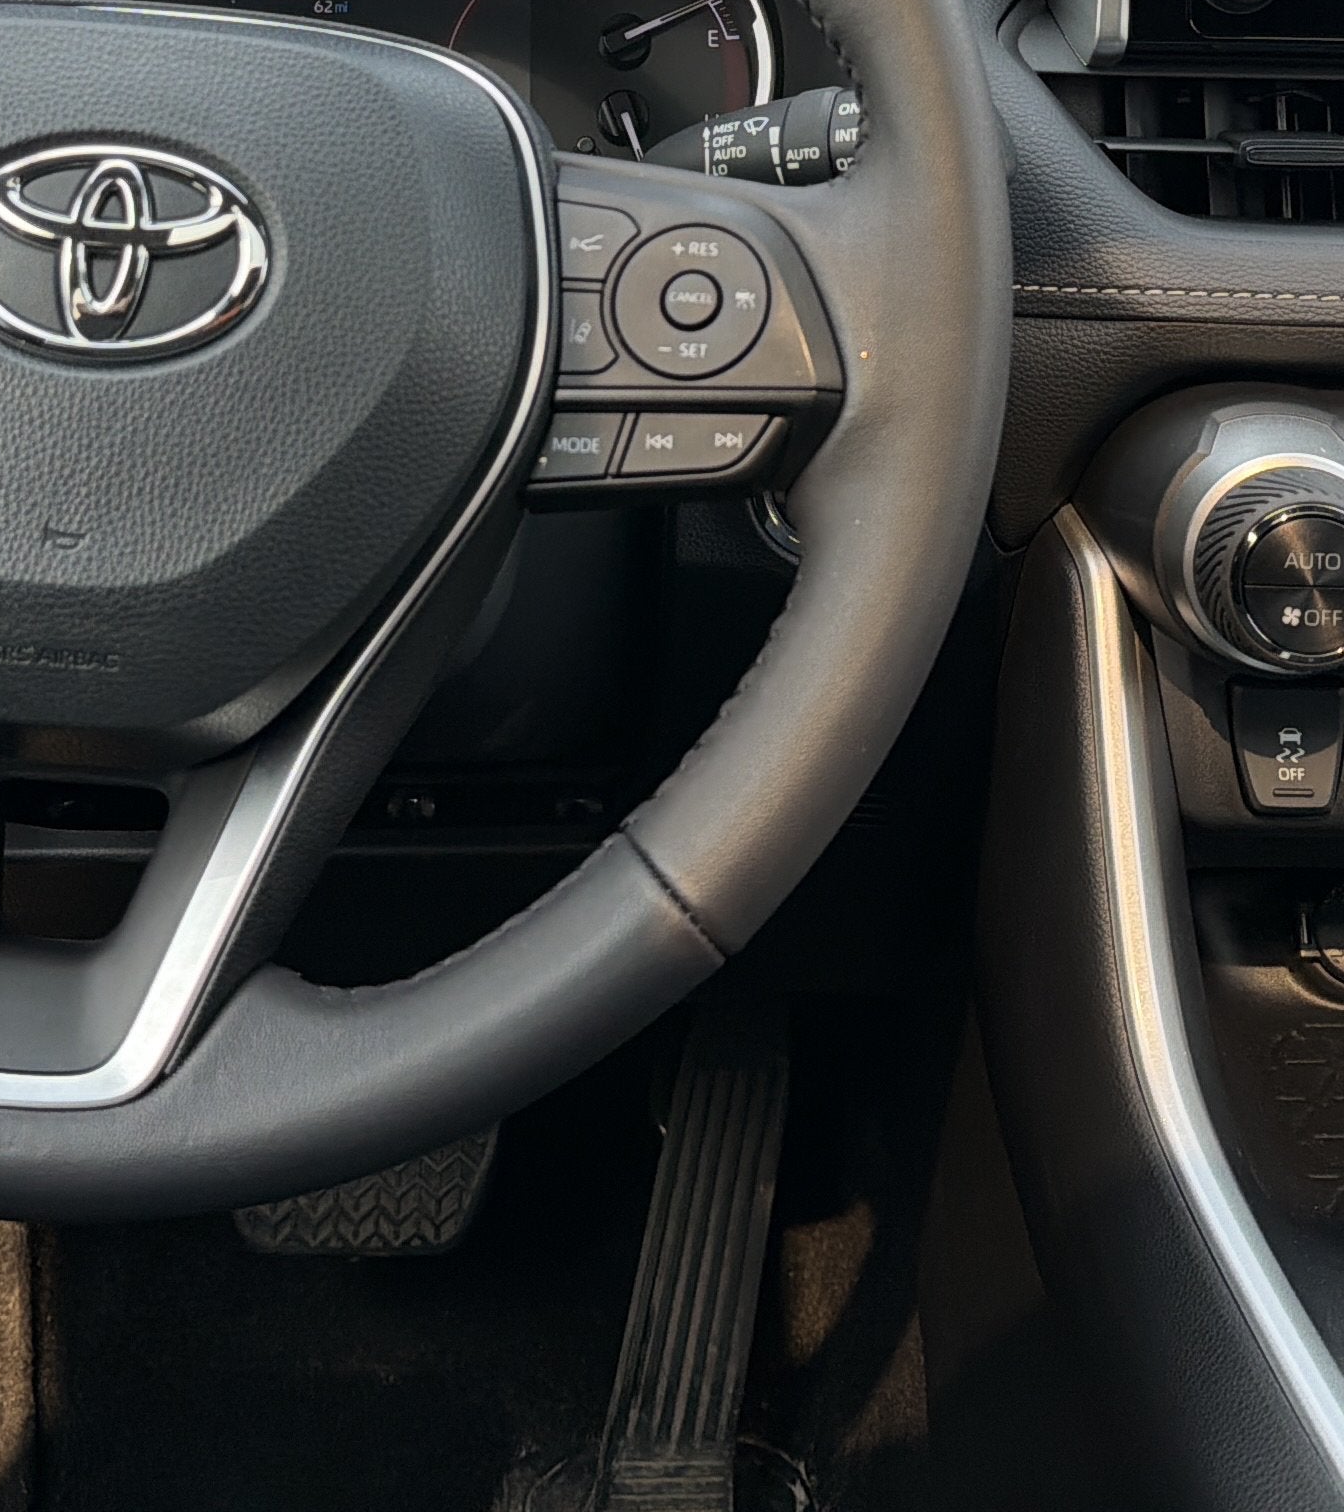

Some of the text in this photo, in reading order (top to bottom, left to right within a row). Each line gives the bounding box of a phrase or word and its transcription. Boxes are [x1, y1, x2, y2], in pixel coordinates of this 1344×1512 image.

[313, 1, 348, 13] 62 mi
[708, 30, 719, 47] E
[713, 121, 741, 135] MIST
[712, 134, 735, 148] OFF
[713, 146, 747, 161] AUTO
[785, 147, 821, 161] AUTO
[712, 164, 728, 176] LO
[688, 241, 719, 257] RES
[668, 291, 715, 304] CANCEL
[679, 343, 707, 358] SET
[553, 437, 600, 453] MODE
[1283, 552, 1341, 570] AUTO
[1304, 609, 1343, 627] OFF
[1278, 767, 1306, 781] OFF
